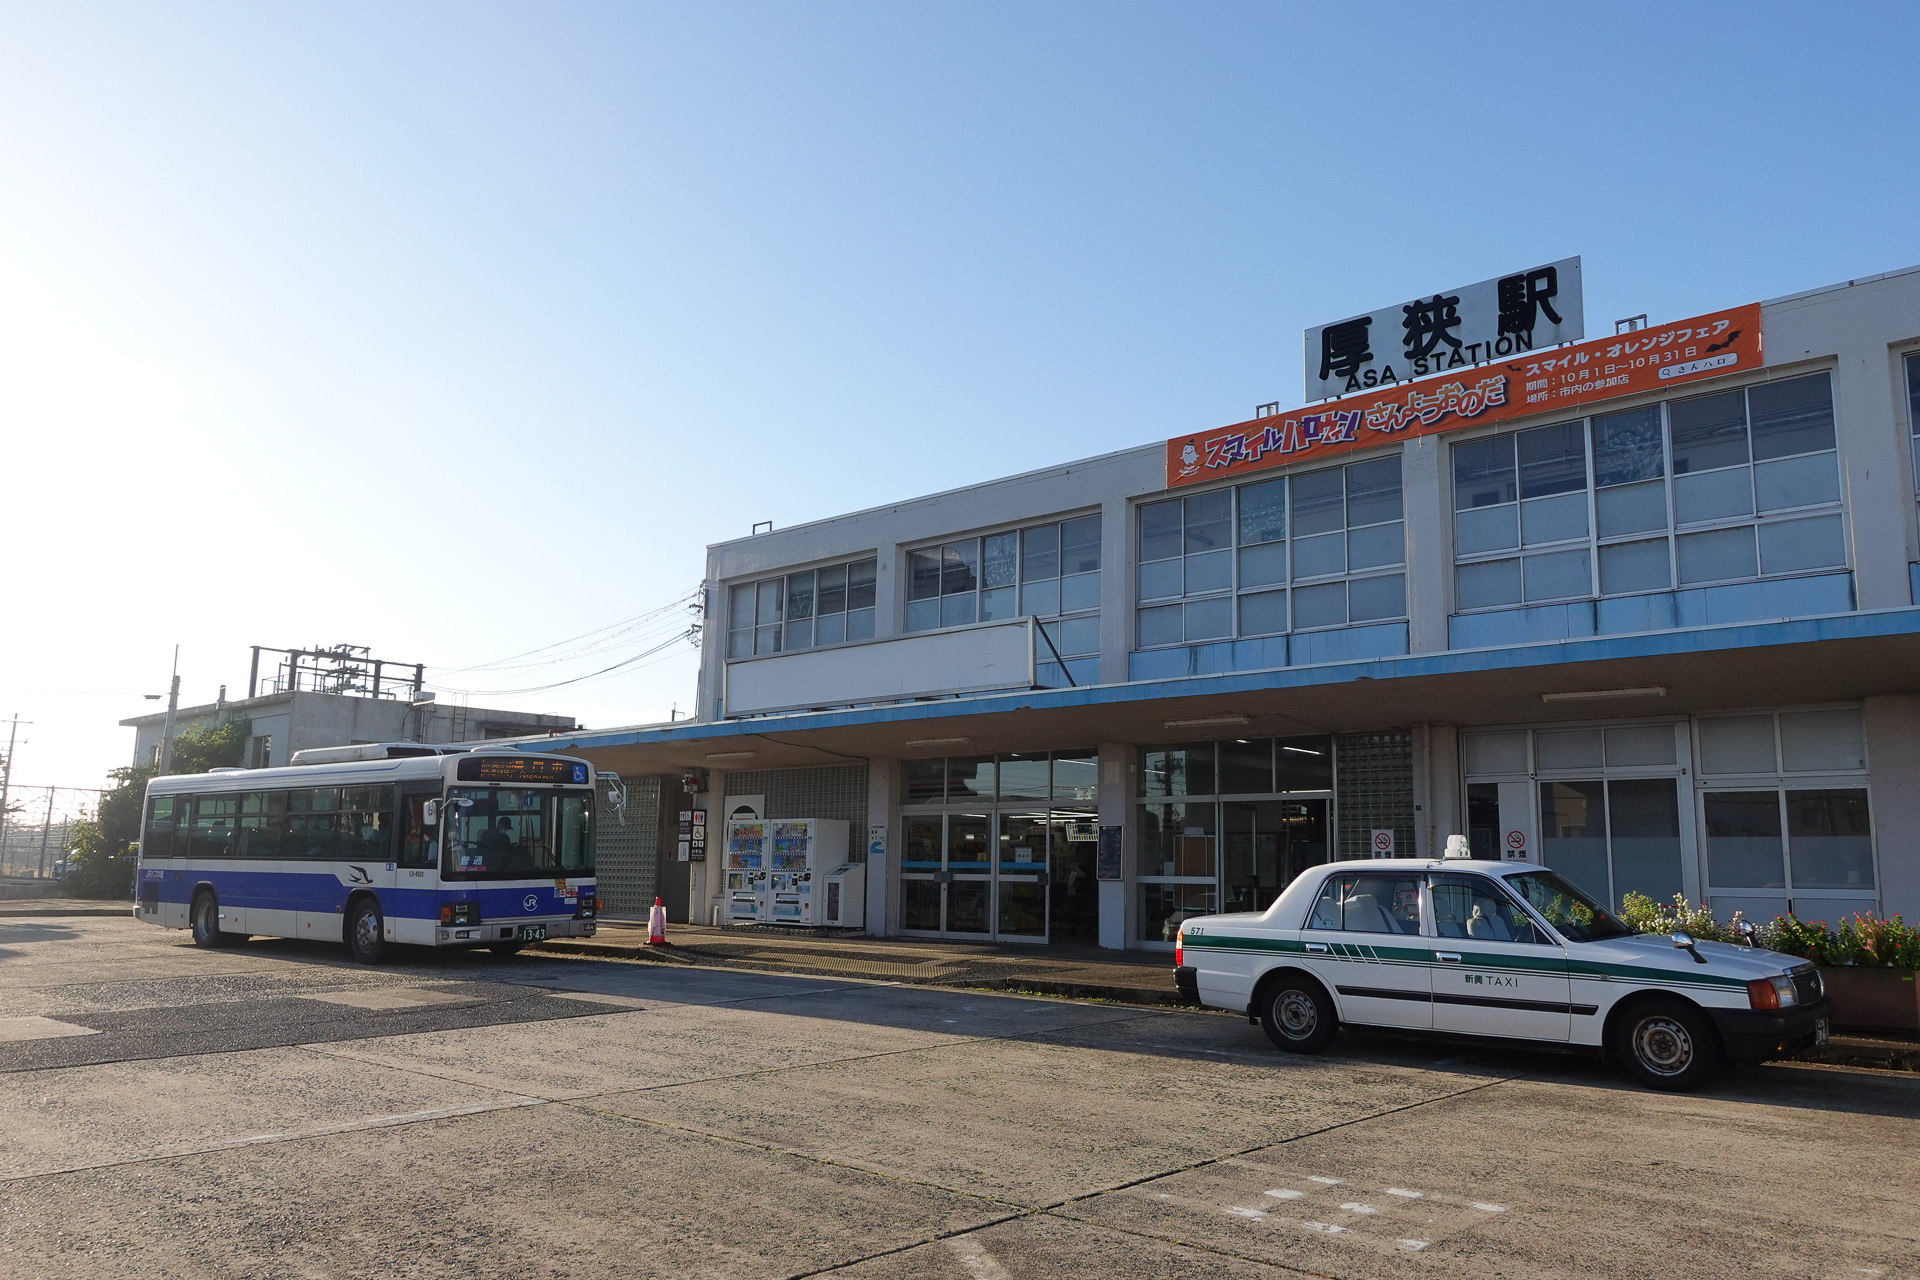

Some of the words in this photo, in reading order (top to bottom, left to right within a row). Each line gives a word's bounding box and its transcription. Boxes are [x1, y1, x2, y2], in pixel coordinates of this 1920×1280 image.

[1319, 266, 1563, 380] 厚狭駅
[1344, 364, 1397, 392] ASA
[1413, 330, 1533, 375] STATION
[1507, 850, 1527, 858] 禁煙
[460, 855, 483, 866] 普通
[1190, 926, 1204, 935] 571
[1485, 975, 1518, 987] TAXI
